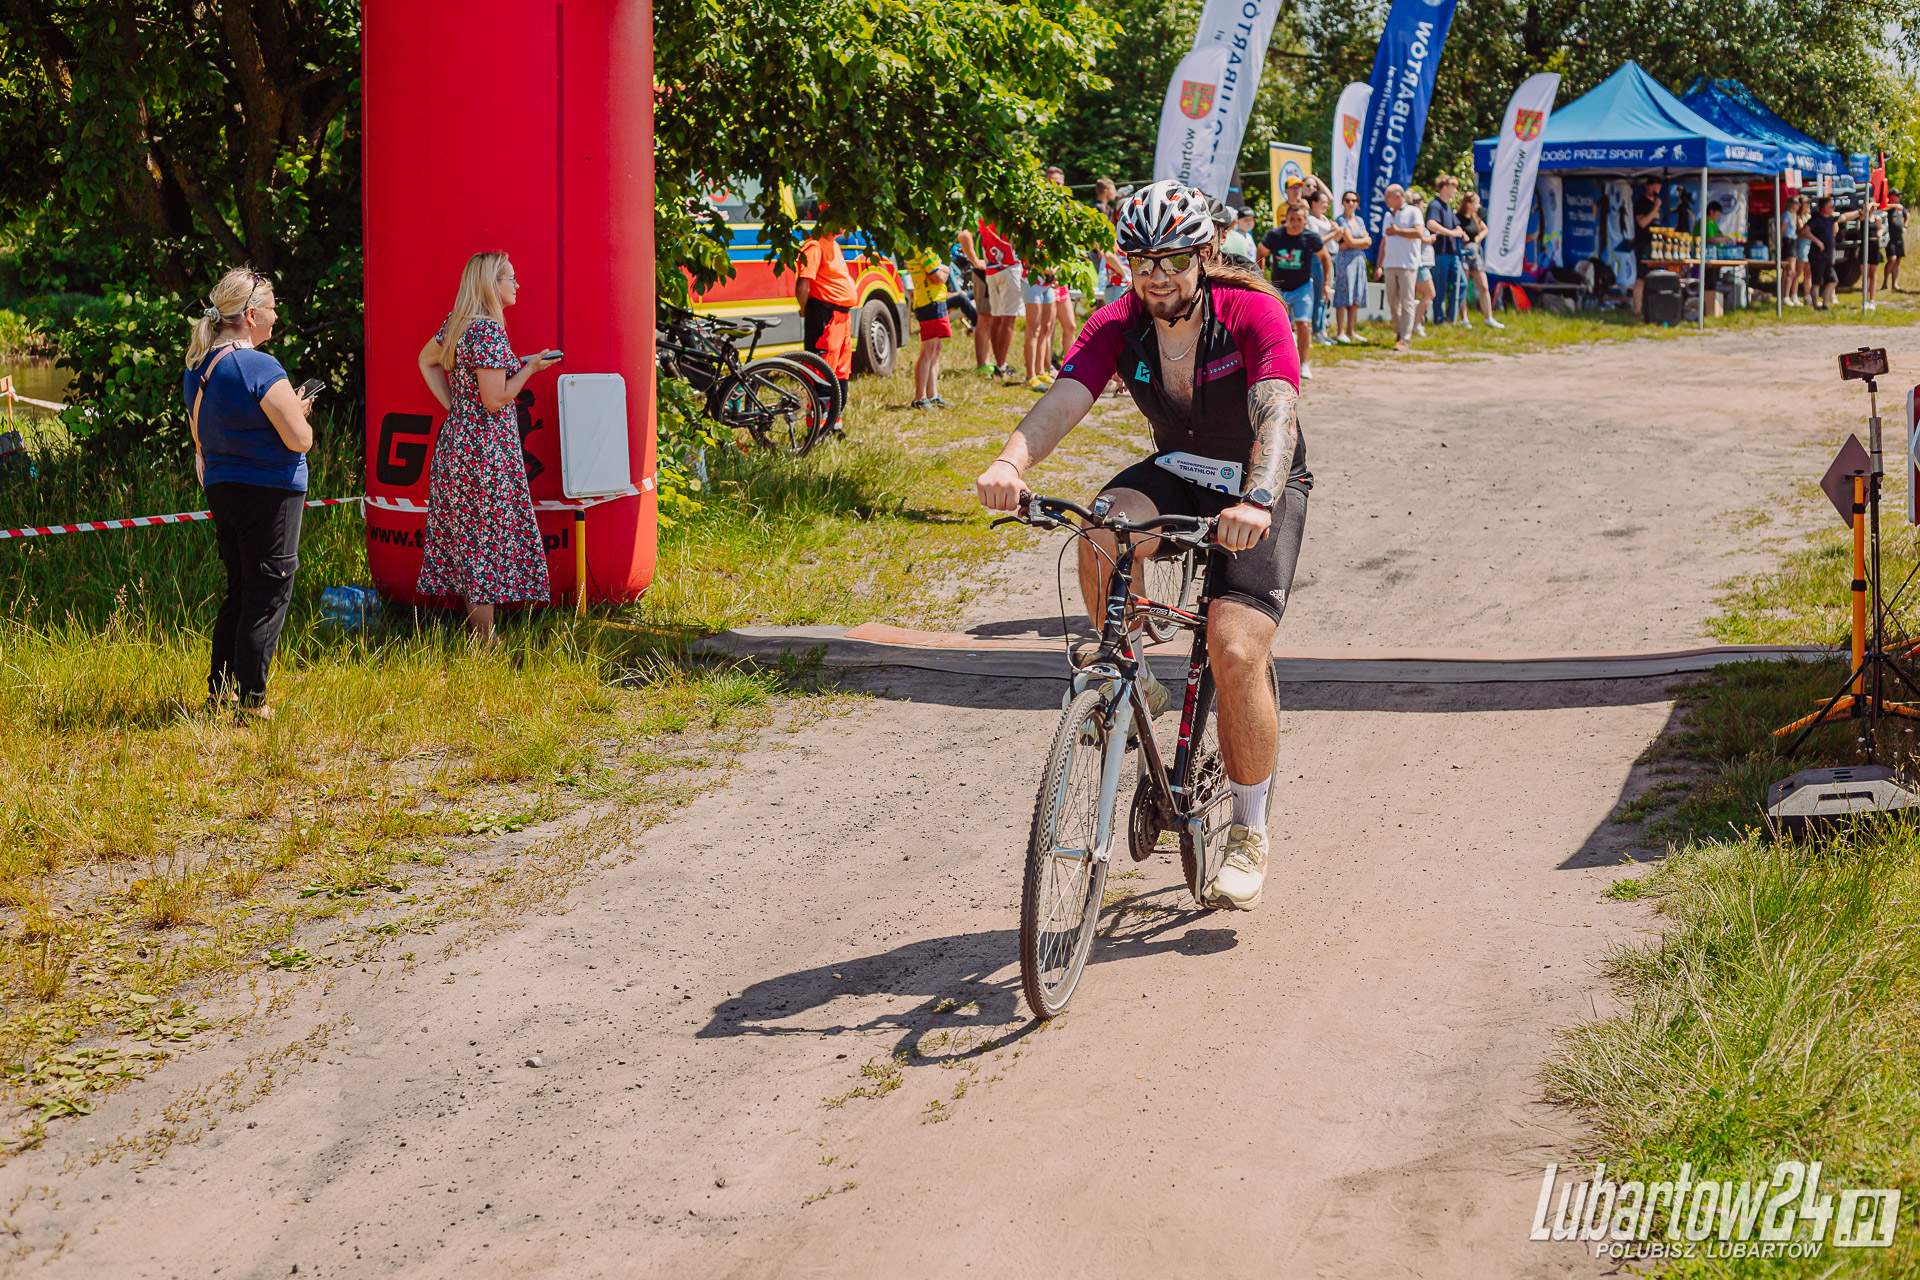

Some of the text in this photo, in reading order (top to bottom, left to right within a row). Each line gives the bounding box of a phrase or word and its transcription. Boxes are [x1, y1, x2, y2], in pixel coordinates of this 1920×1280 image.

[1178, 128, 1196, 187] ubartów
[1541, 147, 1644, 162] DOŚĆ PRZEZ SPORT
[1499, 148, 1527, 257] Gmina Lubartów
[1179, 464, 1216, 476] TRIATHLON
